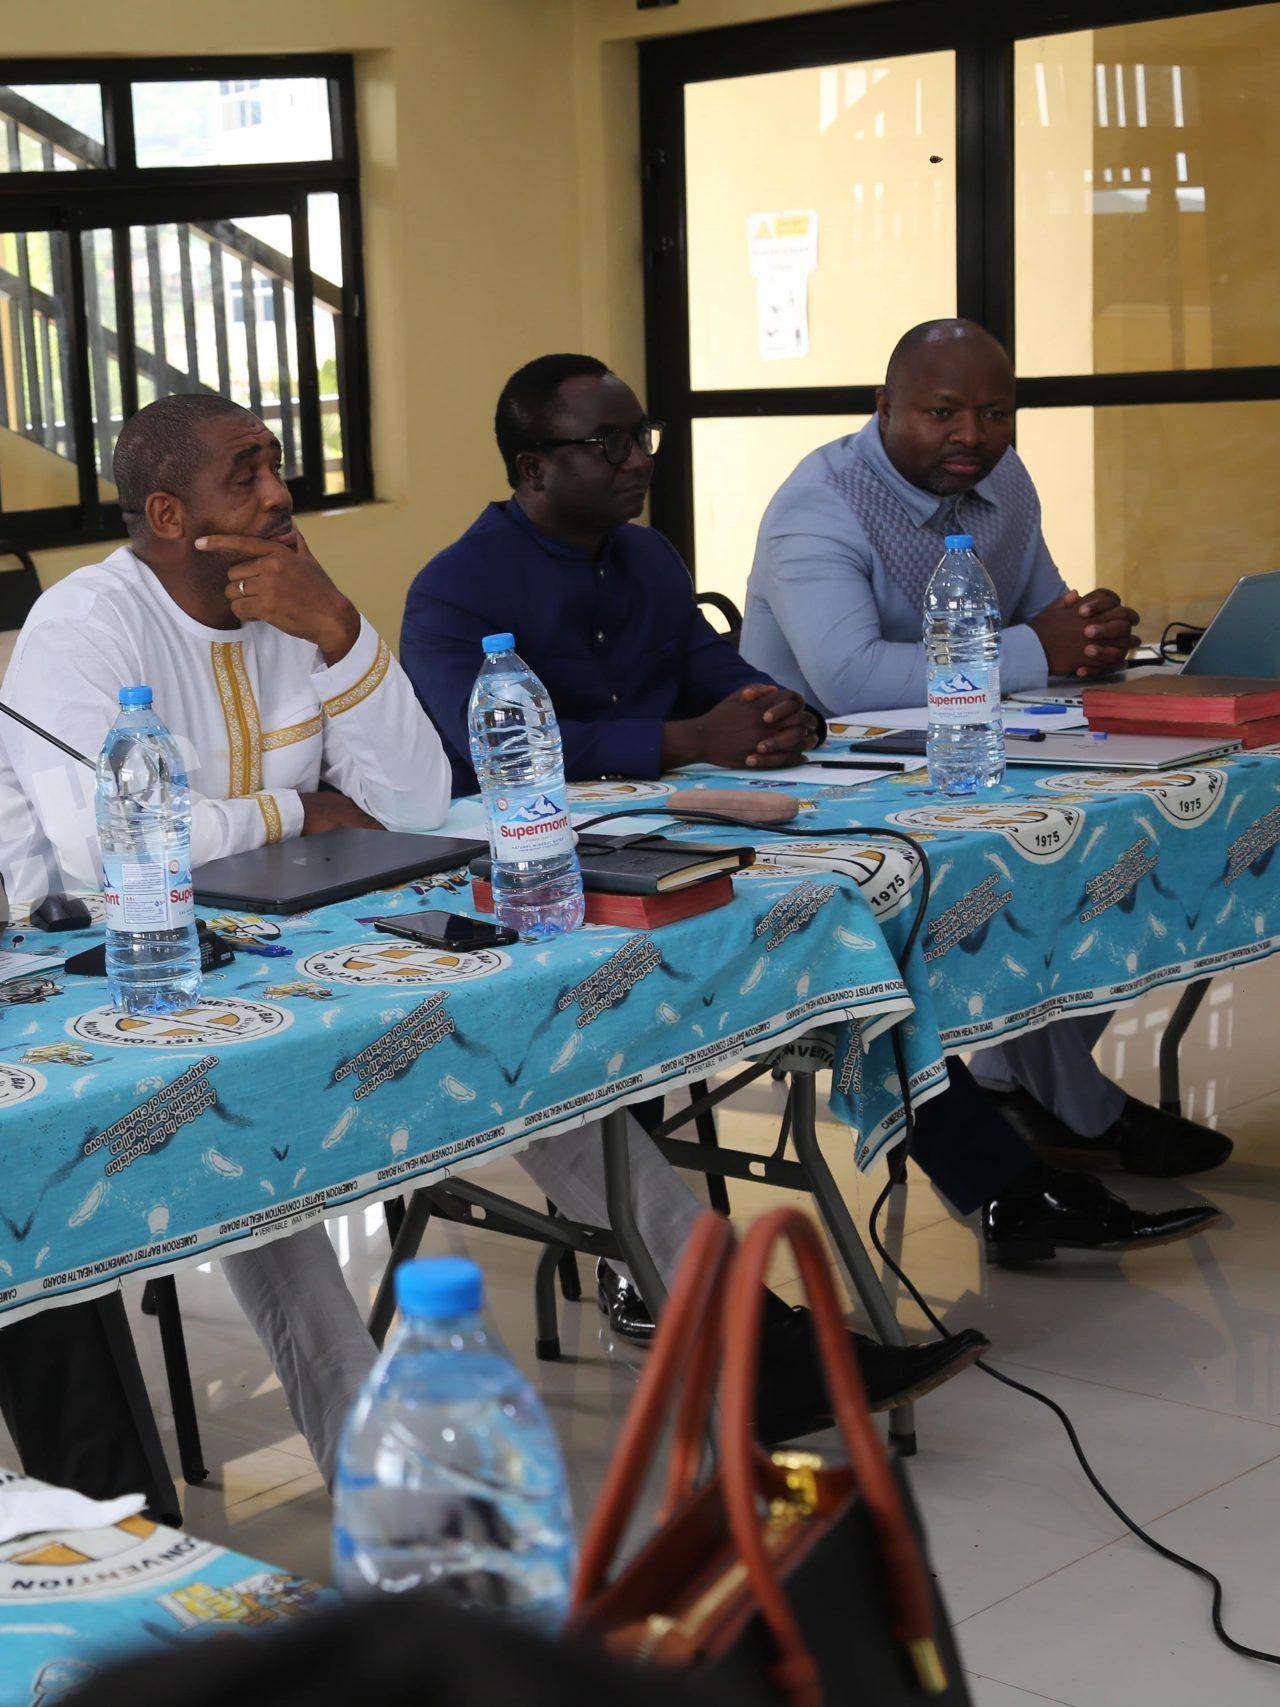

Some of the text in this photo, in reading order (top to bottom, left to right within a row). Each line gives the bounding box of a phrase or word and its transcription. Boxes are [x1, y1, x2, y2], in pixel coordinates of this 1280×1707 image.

[928, 693, 986, 707] Supermont
[1180, 798, 1201, 812] 1975
[500, 816, 568, 840] Supermont
[1035, 831, 1060, 847] 1975
[871, 874, 905, 906] 1975
[816, 990, 854, 1005] CONVENTION
[855, 984, 883, 997] BAPTIST
[885, 981, 904, 991] ROON
[559, 991, 577, 1010] Love
[577, 994, 611, 1027] Provision
[1057, 996, 1075, 1005] HEALTH
[1075, 992, 1093, 1001] BOARD
[401, 995, 442, 1029] expression
[410, 1016, 438, 1043] Health
[357, 1032, 392, 1062] Christian
[381, 1050, 391, 1063] to
[391, 1036, 410, 1055] Care
[660, 1021, 770, 1074] CAMEROON BAPTIST CONVENTION HEALTH BOARD
[335, 1060, 357, 1080] Love
[355, 1019, 454, 1099] Assisting in the Provision
[369, 1057, 382, 1073] all
[359, 1066, 369, 1080] as
[837, 1049, 858, 1094] Assisting
[918, 1064, 942, 1083] HEALTH
[85, 1056, 217, 1155] an expression of Christian Love
[524, 1074, 643, 1126] CAMEROON BAPTIST CONVENTION HEALTH BOARD
[111, 1080, 207, 1154] of Health Care to all as
[881, 1107, 906, 1130] CAMERO
[106, 1090, 215, 1176] Assisting in the Provision
[377, 1127, 505, 1181] CAMEROON BAPTIST CONVENTION HEALTH BOARD
[219, 1181, 358, 1234] CAMEROON BAPTIST CONVENTION HEALTH BOARD
[259, 1220, 288, 1236] VERITABLE
[43, 1234, 198, 1288] CAMEROON BAPTIST CONVENTION HEALTH BOARD
[9, 1538, 196, 1592] ONVENTION
